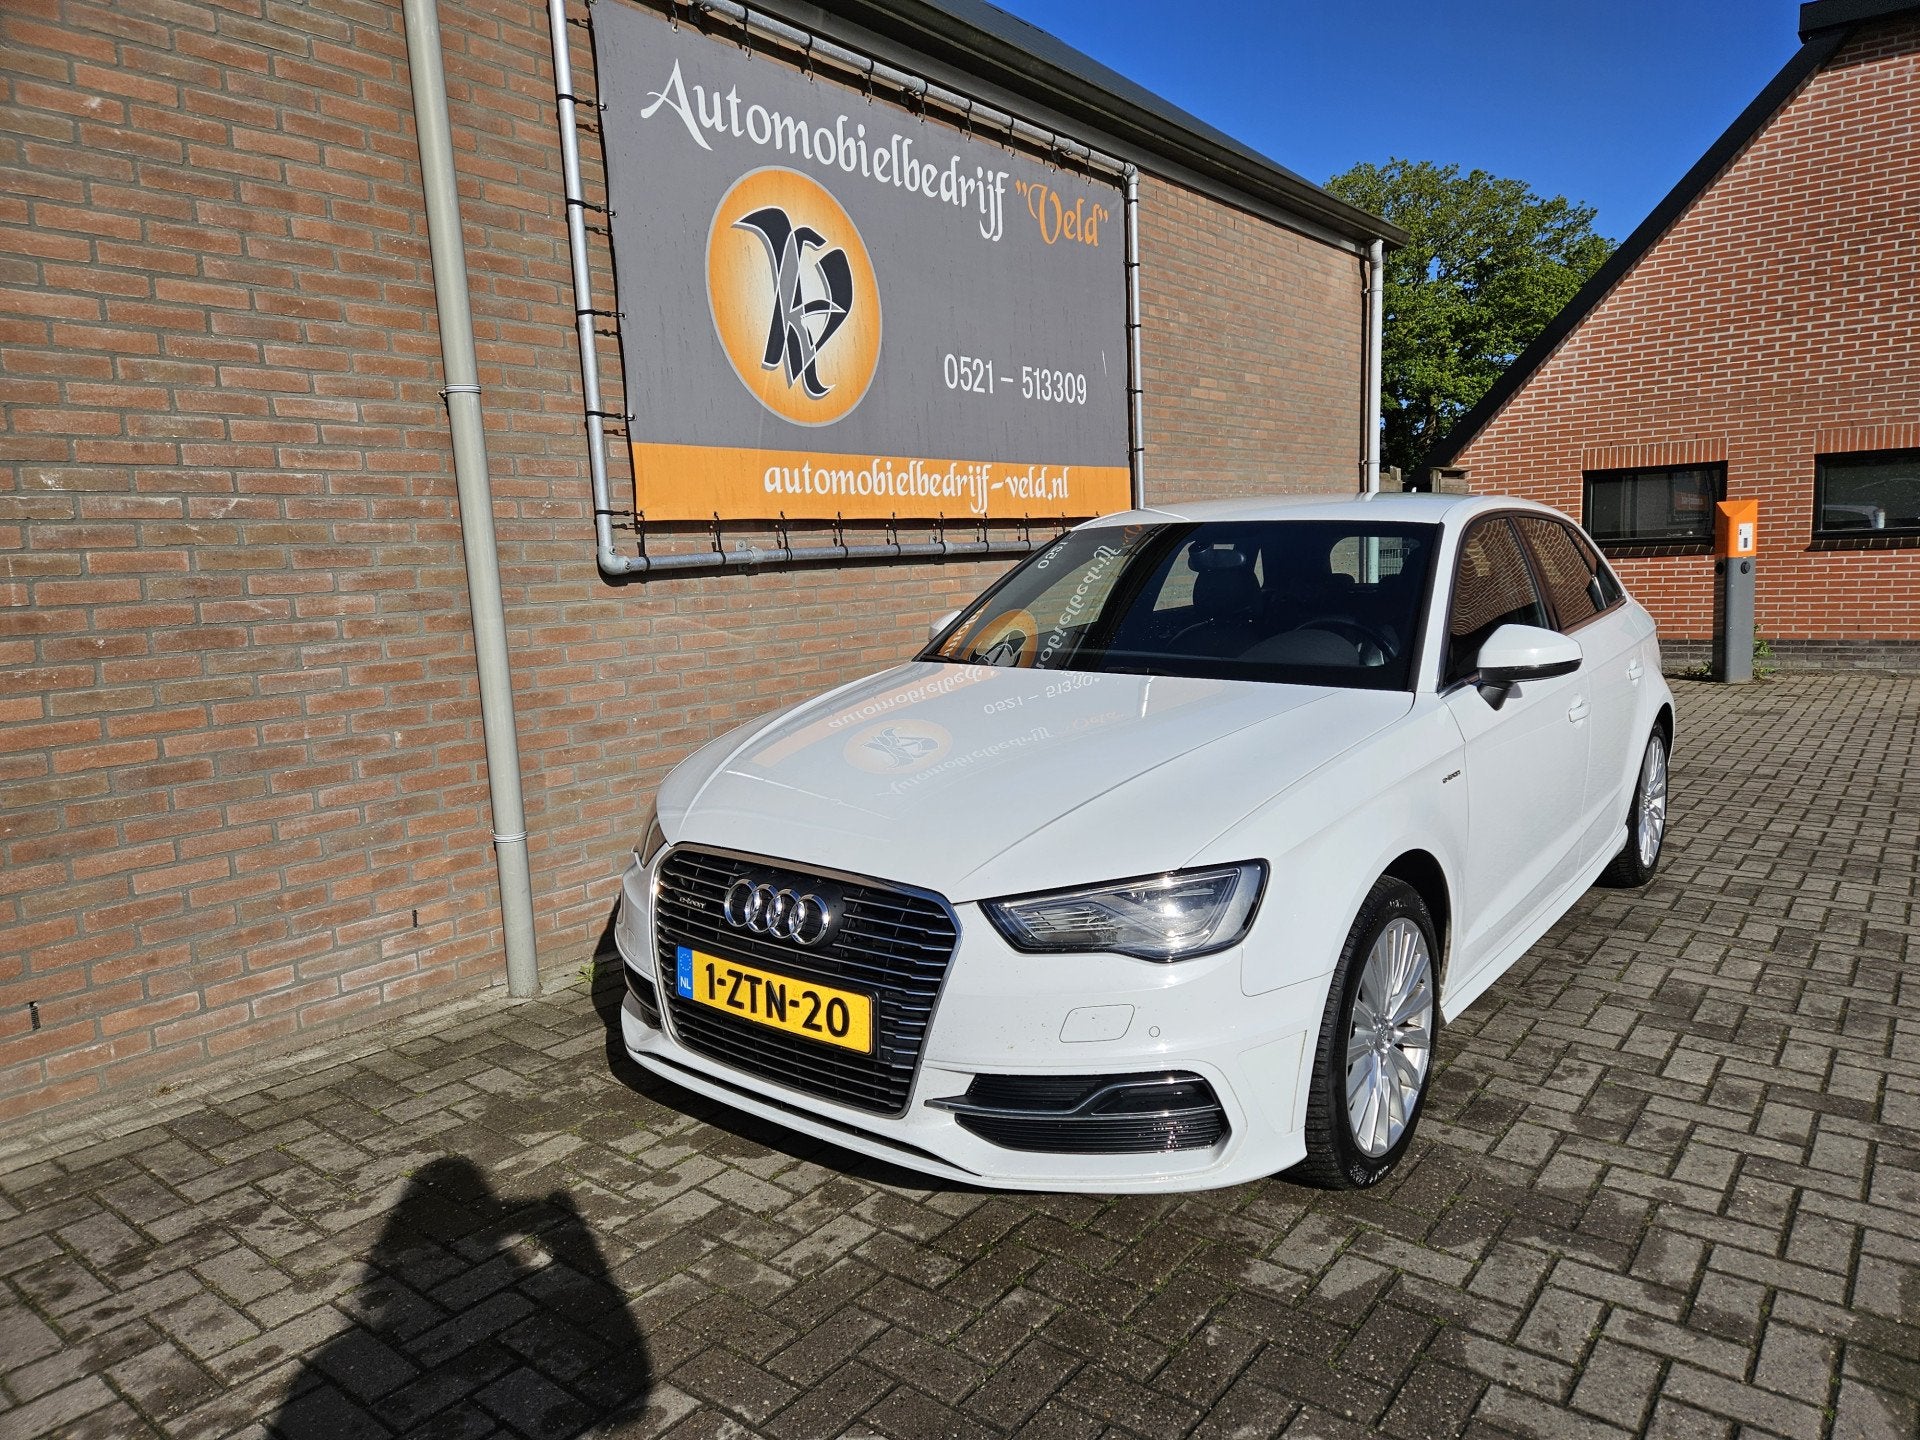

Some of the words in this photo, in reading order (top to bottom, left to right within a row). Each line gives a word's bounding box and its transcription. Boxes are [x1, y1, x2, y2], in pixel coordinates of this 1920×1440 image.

[641, 58, 1009, 242] Automobielbedrijf
[944, 353, 994, 394] 0521
[1022, 365, 1087, 405] 513309
[764, 458, 1070, 514] automobielbedrijf-veld.nl
[680, 976, 691, 990] NL
[705, 962, 850, 1038] 1-ZTN-20
